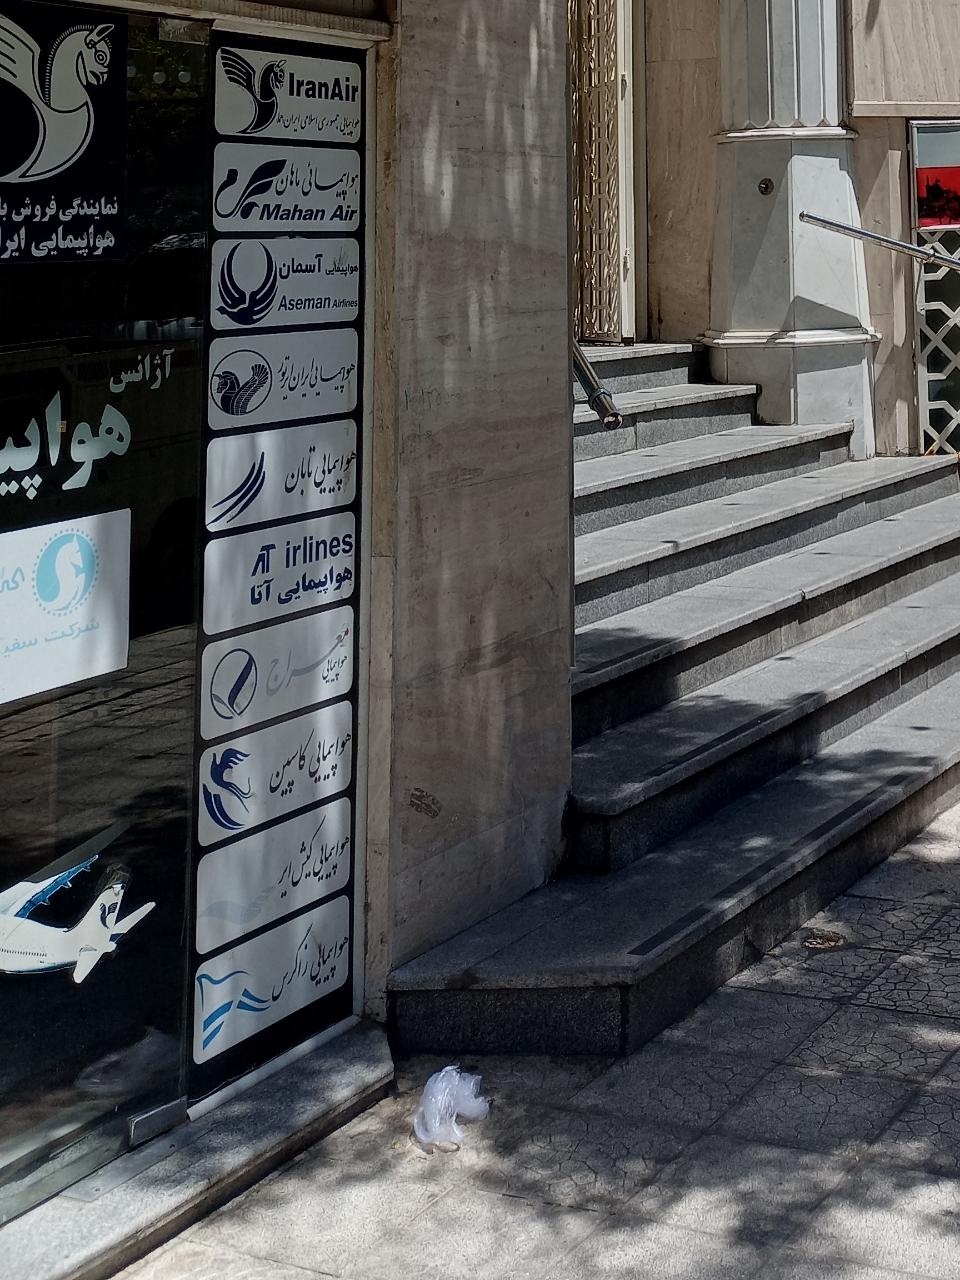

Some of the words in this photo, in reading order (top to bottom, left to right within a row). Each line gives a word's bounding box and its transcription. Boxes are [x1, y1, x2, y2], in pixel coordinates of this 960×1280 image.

[289, 72, 359, 103] IranAir
[301, 113, 318, 129] اسلامی
[318, 114, 339, 131] جمهوری
[276, 163, 300, 196] ماهان
[12, 195, 57, 222] فروش
[59, 196, 118, 222] نمایندگی
[258, 203, 326, 221] Mahan
[329, 204, 357, 221] Air
[31, 225, 115, 257] هواپیمایی
[279, 254, 323, 280] آسمان
[325, 263, 359, 278] هواپیمایی
[277, 295, 331, 312] Aseman
[332, 298, 358, 309] Airlines
[109, 348, 175, 393] آژانس
[285, 446, 315, 496] تابان
[314, 451, 357, 494] هواپیمایی
[250, 577, 274, 606] آتا
[277, 566, 353, 605] هواپیمایی
[45, 617, 100, 641] شرکت
[266, 627, 349, 697] معراج
[269, 728, 314, 798] کاسپین
[309, 732, 351, 784] هواپیمایی
[291, 815, 326, 888] کیش
[312, 835, 349, 882] هواپیمایی
[278, 863, 291, 898] ایر
[271, 924, 312, 1002] زاگرس
[310, 935, 348, 986] هواپیمایی
